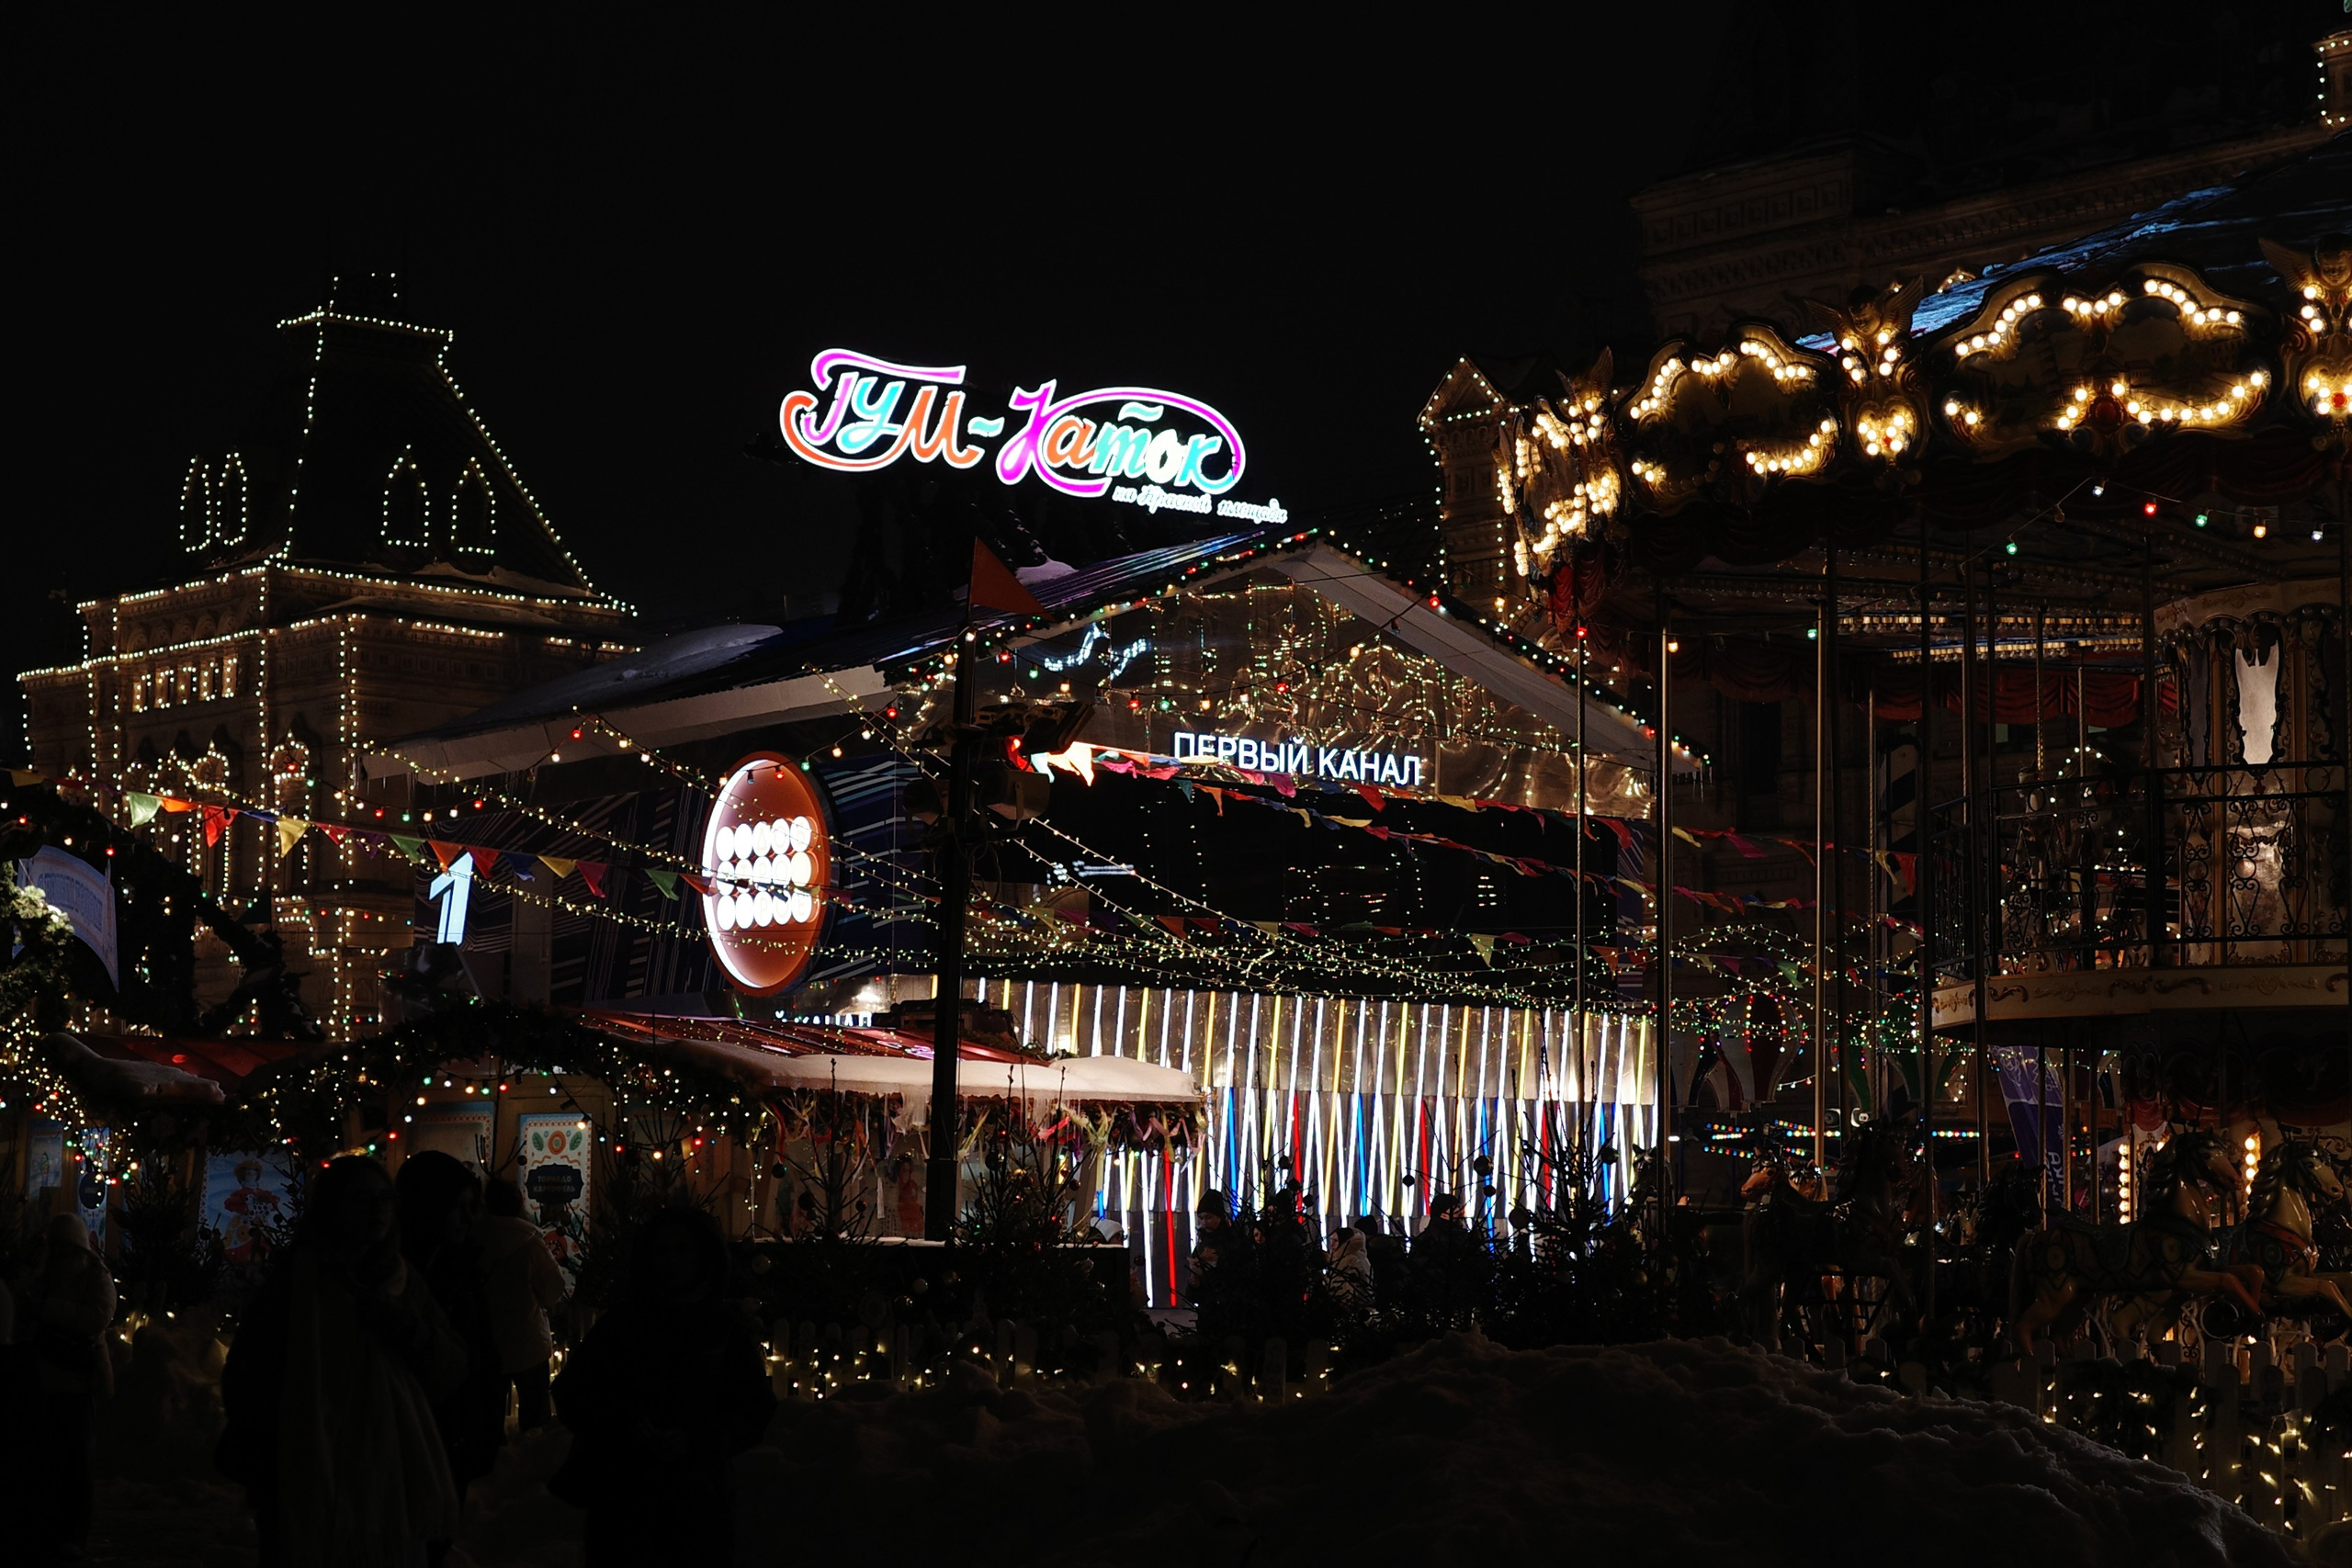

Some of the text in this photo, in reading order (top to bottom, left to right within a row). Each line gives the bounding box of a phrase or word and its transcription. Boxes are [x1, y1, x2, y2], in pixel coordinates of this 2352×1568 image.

[1173, 731, 1421, 786] ПЕРВЫЙ КАНАЛ
[428, 851, 474, 946] 1
